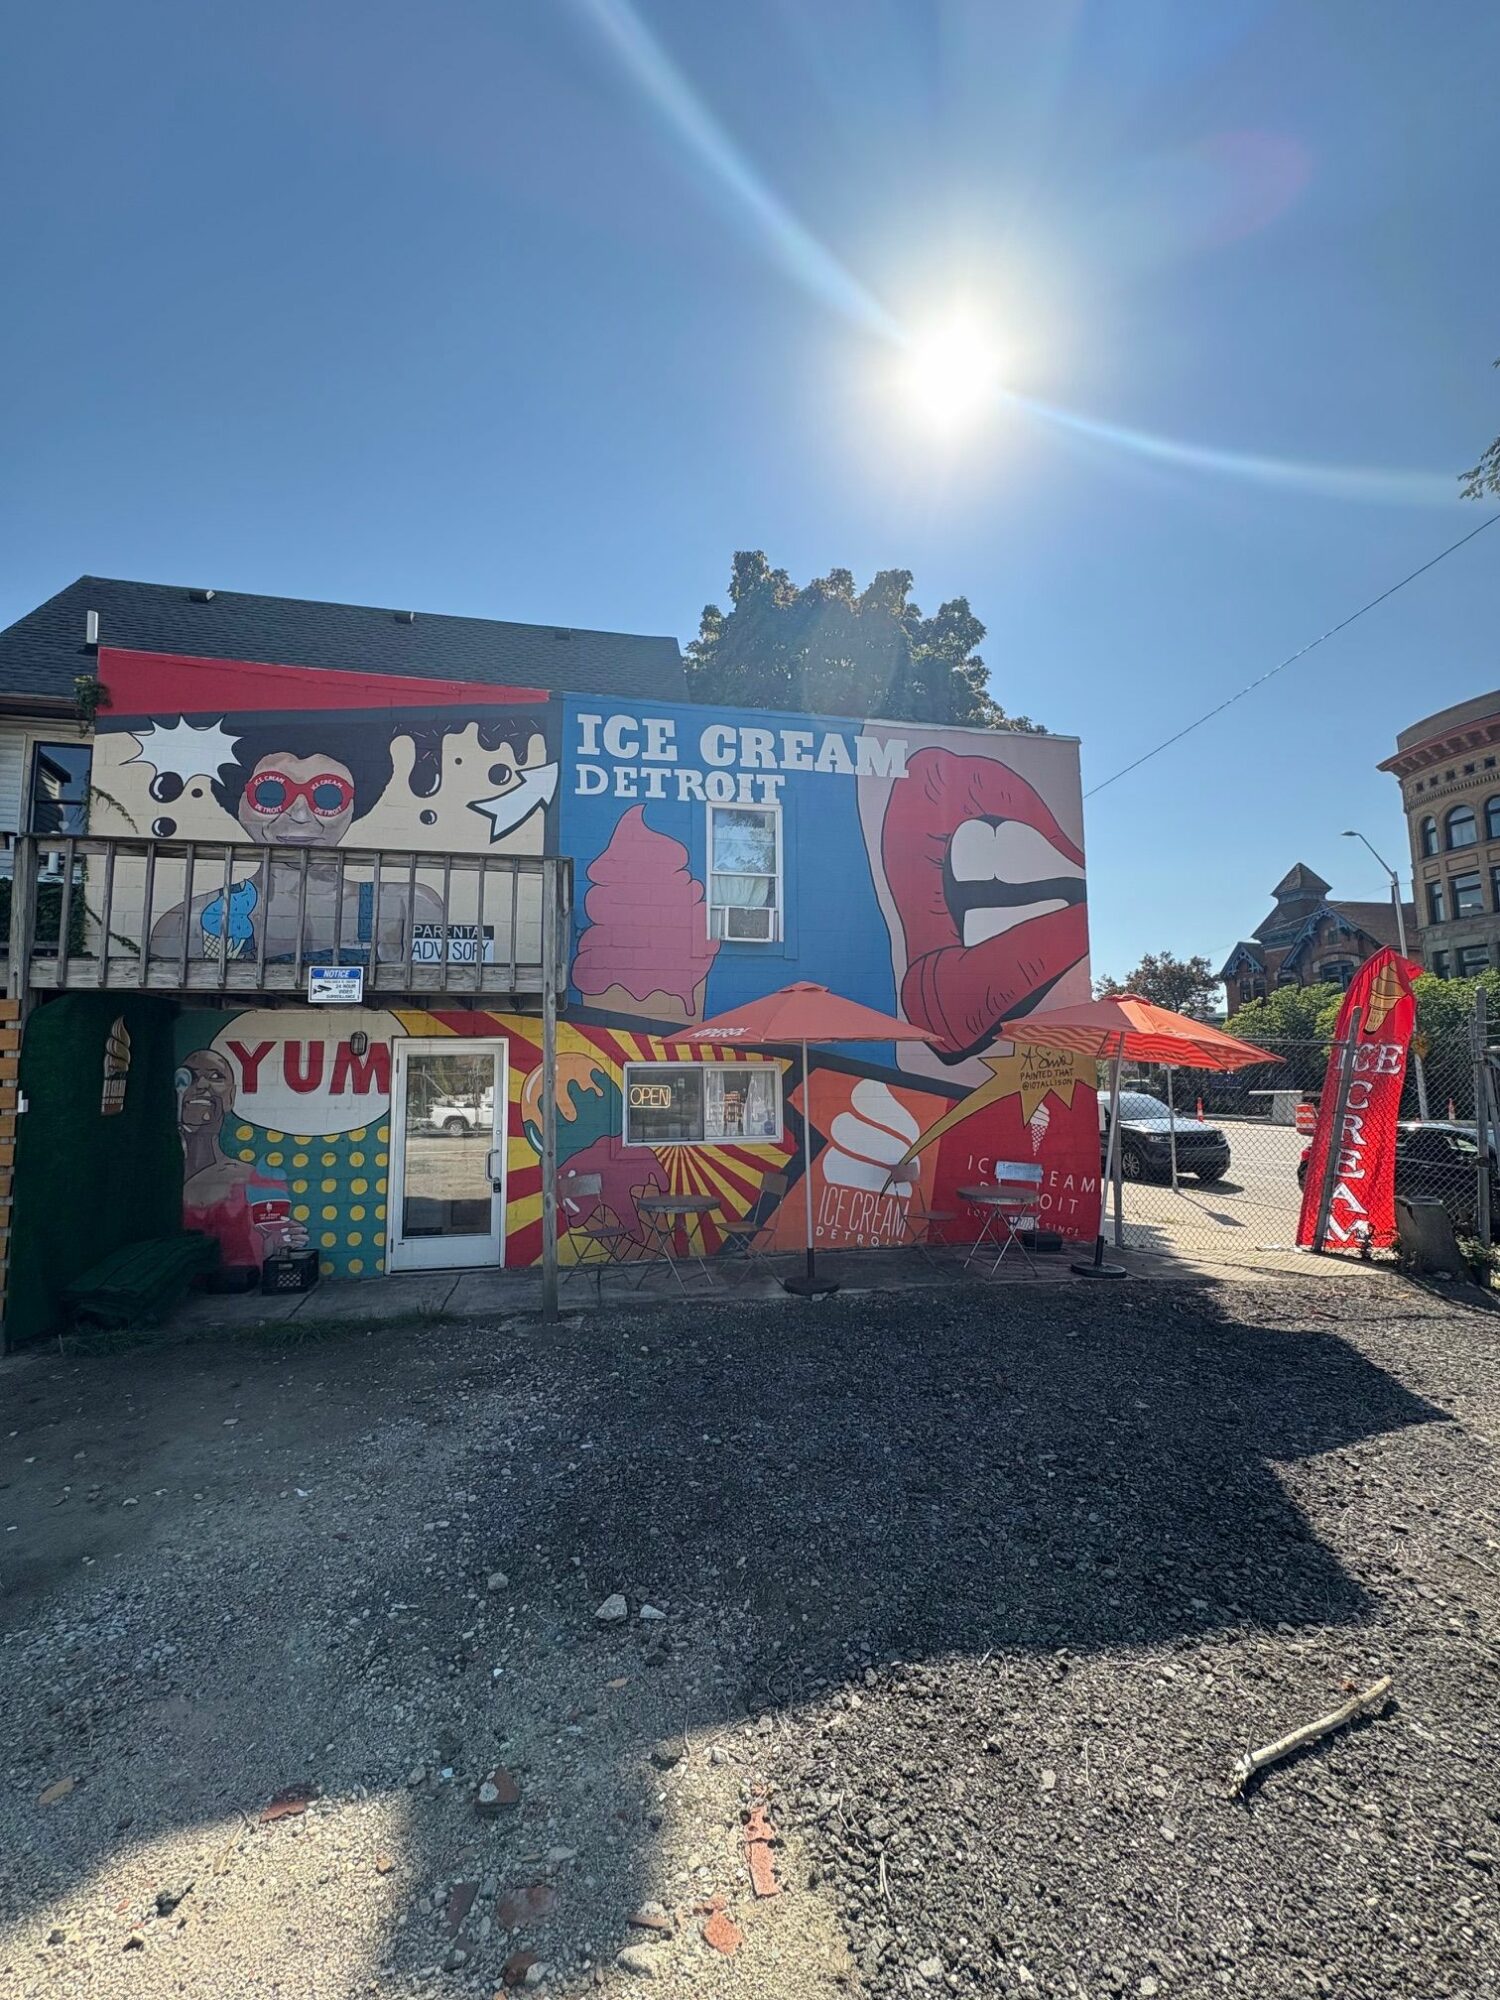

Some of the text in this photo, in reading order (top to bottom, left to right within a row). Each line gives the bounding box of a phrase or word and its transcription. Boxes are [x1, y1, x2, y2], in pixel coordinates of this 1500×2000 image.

[577, 713, 909, 778] ICE CREAM
[575, 763, 785, 804] DETROIT
[254, 803, 283, 813] DETROIT
[314, 806, 342, 817] DETROIT
[323, 969, 350, 978] NOTICE
[226, 1040, 390, 1095] YUM
[1020, 1067, 1074, 1081] PAINTED THAT
[630, 1087, 669, 1106] OPEN
[818, 1185, 910, 1238] ICE CREAM
